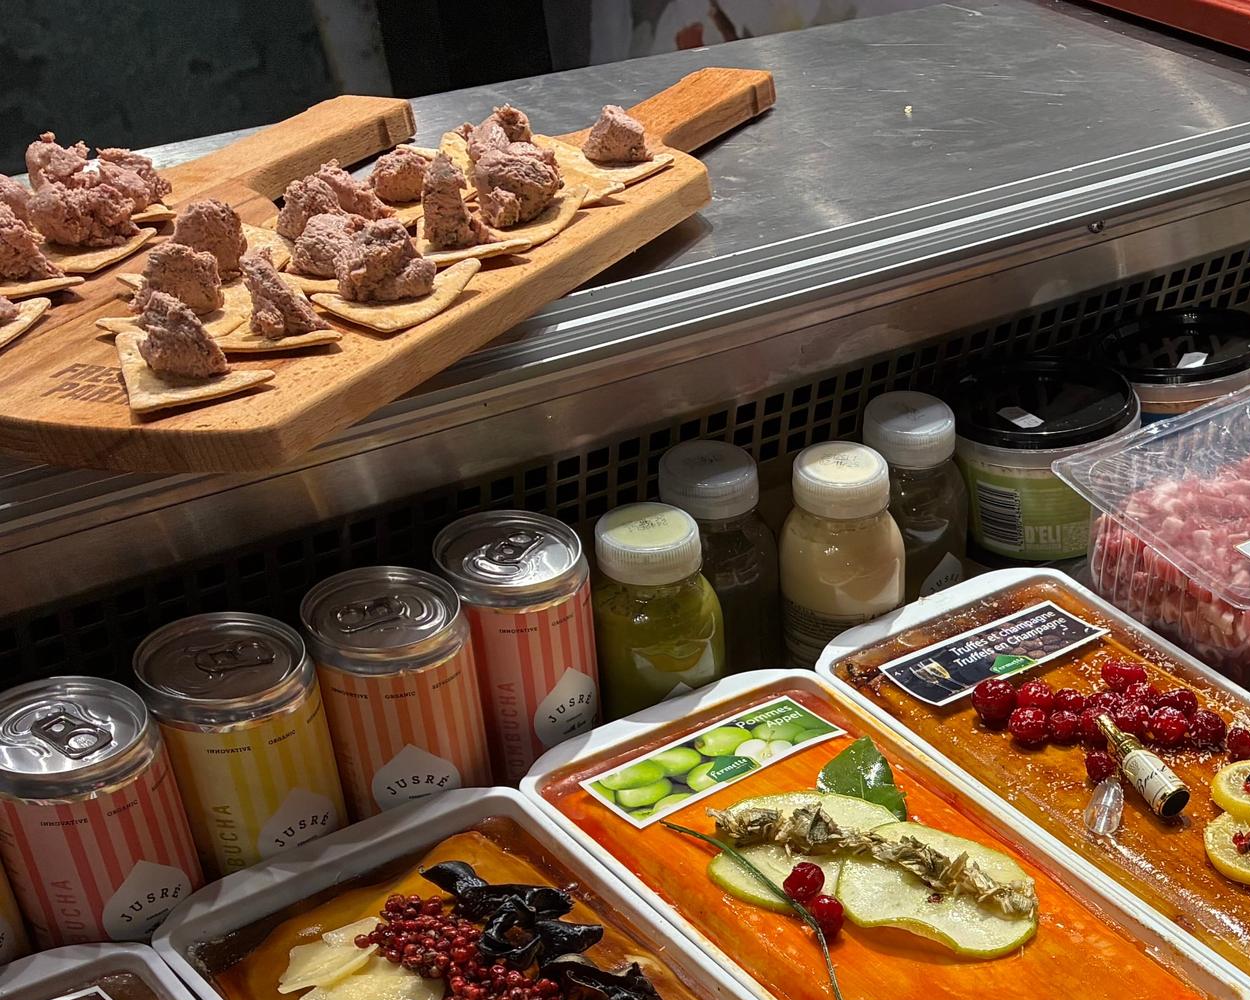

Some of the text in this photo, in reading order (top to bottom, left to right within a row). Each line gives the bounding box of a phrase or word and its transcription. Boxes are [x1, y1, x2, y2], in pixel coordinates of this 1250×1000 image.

[948, 610, 1056, 657] Truffes et champagne
[952, 615, 1066, 669] Truffels en Champagne
[735, 703, 793, 729] Pommes
[766, 711, 803, 729] Appel
[386, 774, 449, 795] JUSRÉ
[275, 812, 329, 848] JUSRÉ
[121, 883, 182, 923] JUSRÉ
